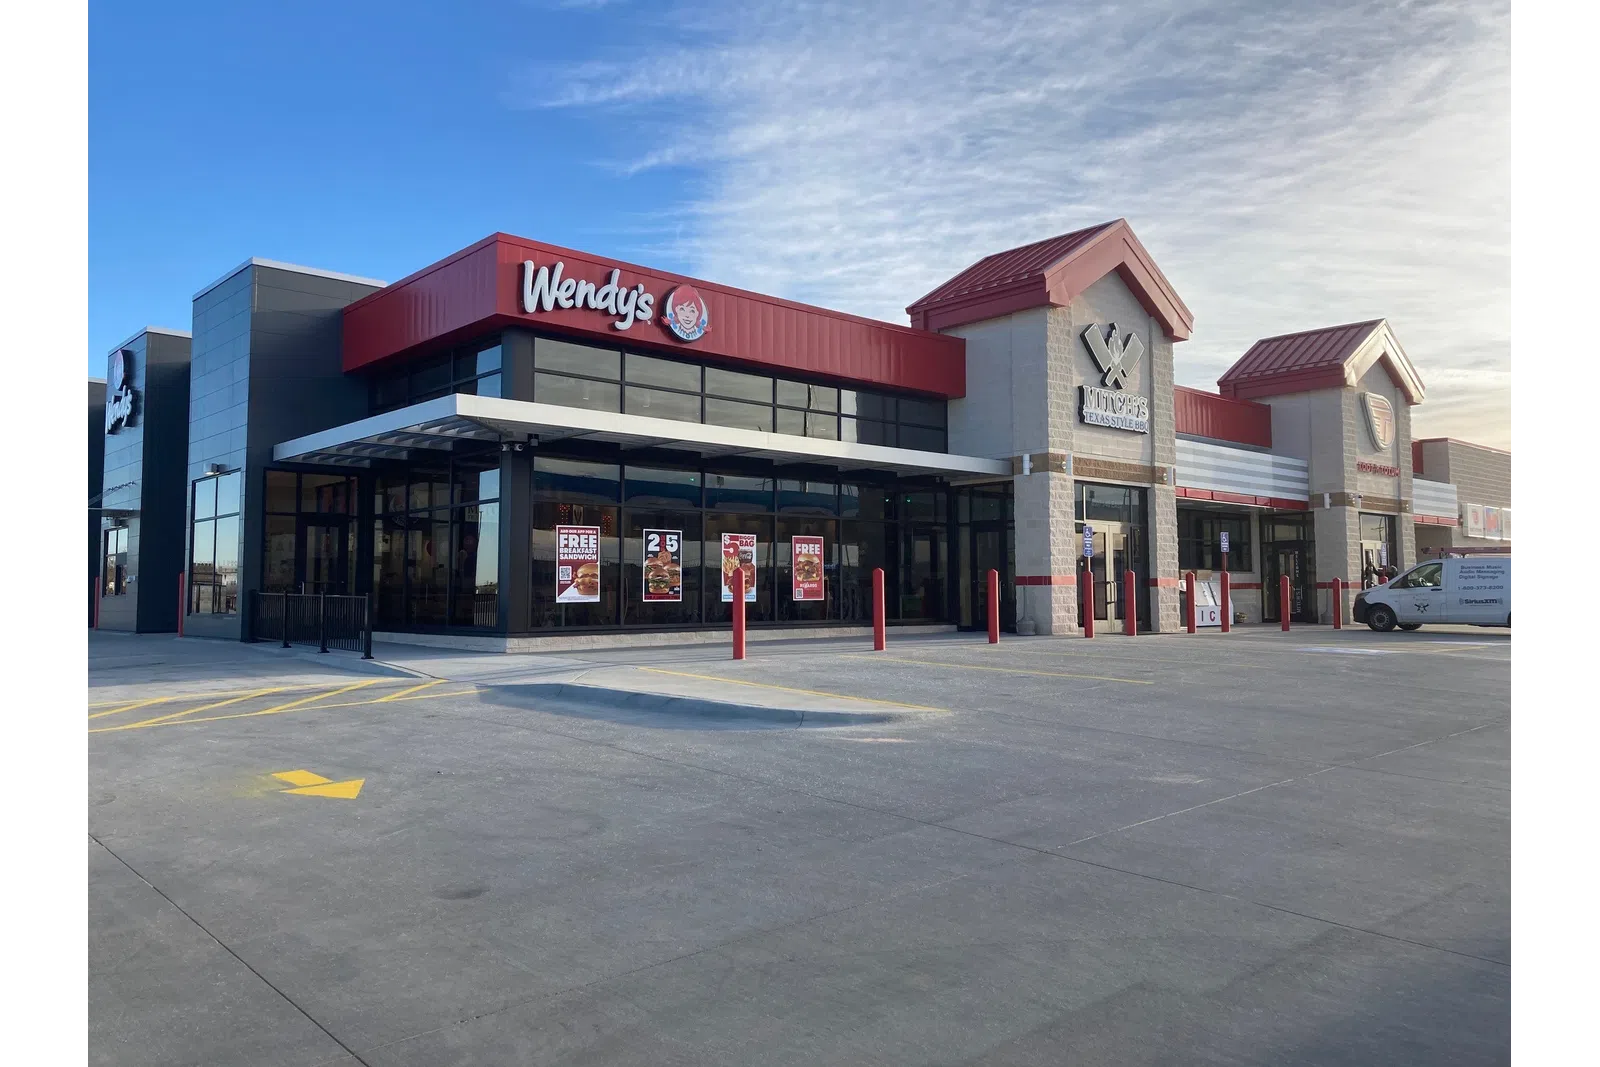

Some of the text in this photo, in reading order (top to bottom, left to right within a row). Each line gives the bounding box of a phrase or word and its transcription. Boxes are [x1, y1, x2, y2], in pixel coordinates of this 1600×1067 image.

[524, 260, 654, 330] Wendy's
[105, 385, 132, 434] Wendy's
[1083, 385, 1148, 419] MITCH'S
[1084, 411, 1149, 432] TEXAS STYLE BBQ
[559, 534, 597, 548] FREE
[648, 533, 660, 551] 2
[796, 543, 820, 555] FREE
